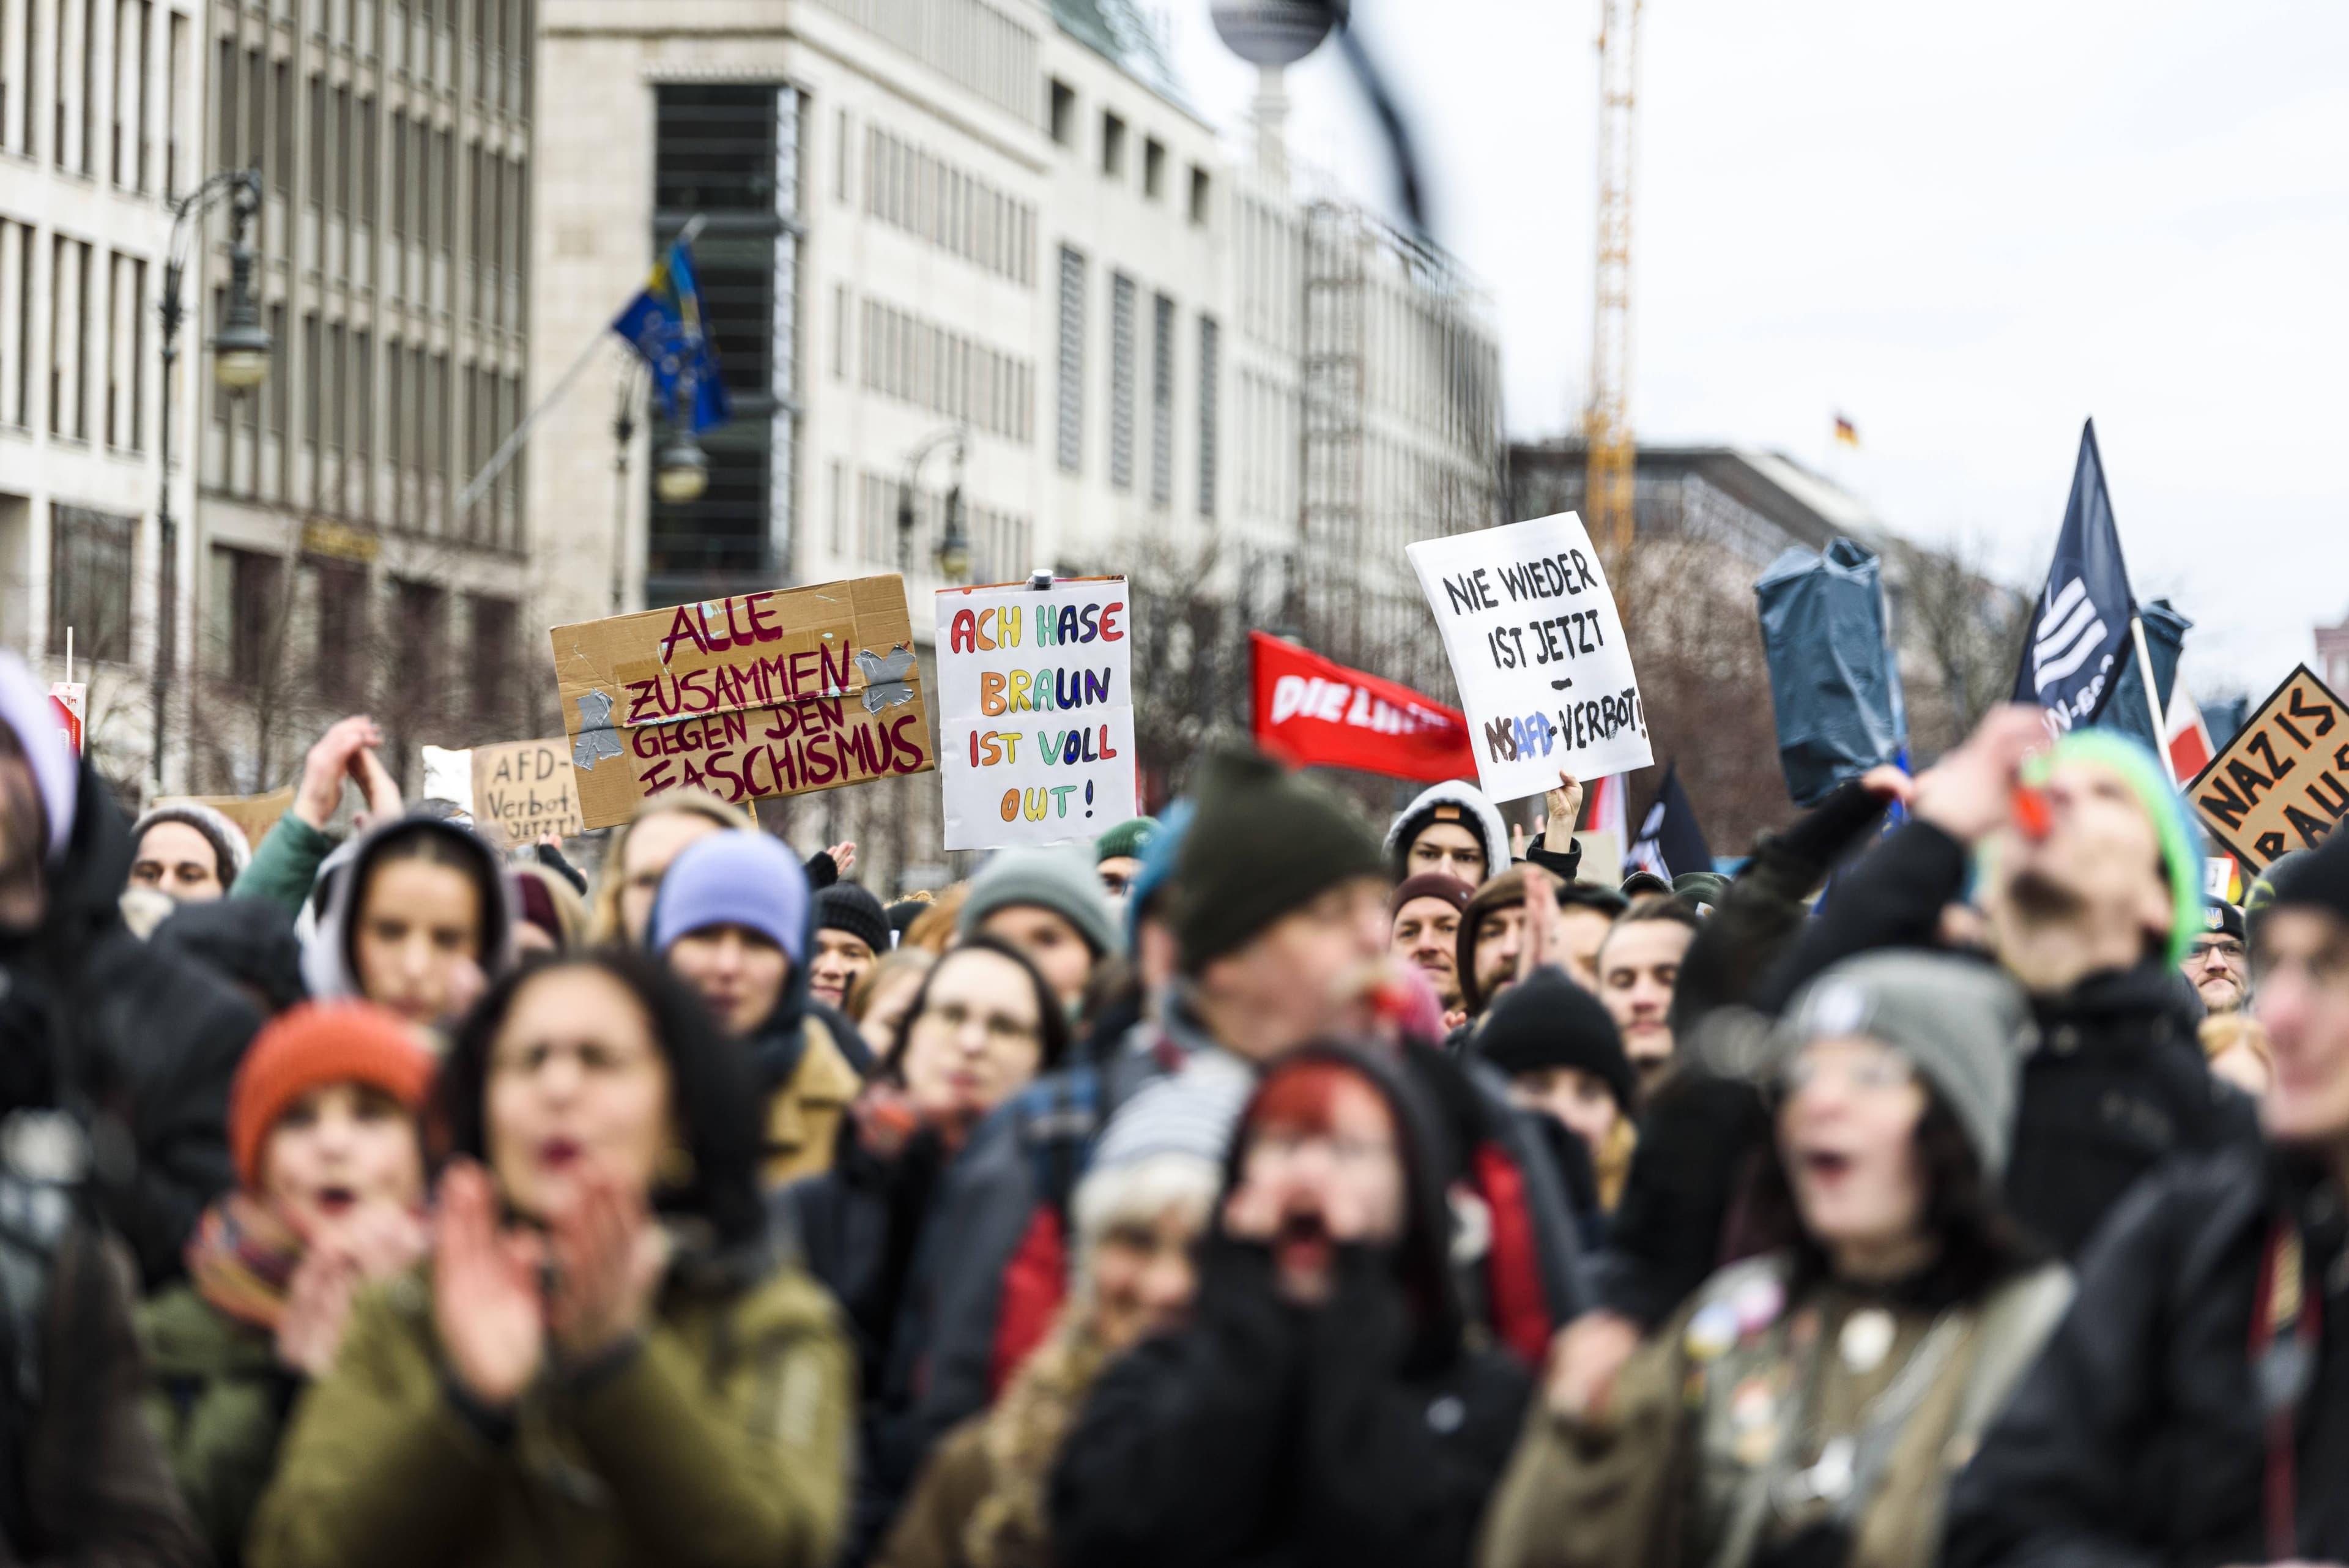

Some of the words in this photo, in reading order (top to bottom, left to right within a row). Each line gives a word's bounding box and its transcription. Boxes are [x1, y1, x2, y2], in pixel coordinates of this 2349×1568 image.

[1443, 568, 1499, 615] NIE
[1499, 549, 1598, 602] WIEDER
[661, 592, 784, 664] ALLE
[950, 605, 1022, 653] ACH
[1036, 601, 1124, 647] HASE
[1488, 626, 1527, 669] IST
[1529, 609, 1604, 665] JETZT
[624, 639, 851, 724] ZUSAMMEN
[980, 667, 1111, 716] BRAUN
[1270, 675, 1352, 726] DIE
[632, 711, 748, 759] GEGEN
[762, 698, 845, 740] DEN
[970, 730, 1023, 768] IST
[1037, 724, 1117, 766] VOLL
[2198, 687, 2336, 831] NAZIS
[639, 715, 924, 804] FASCHISMUS
